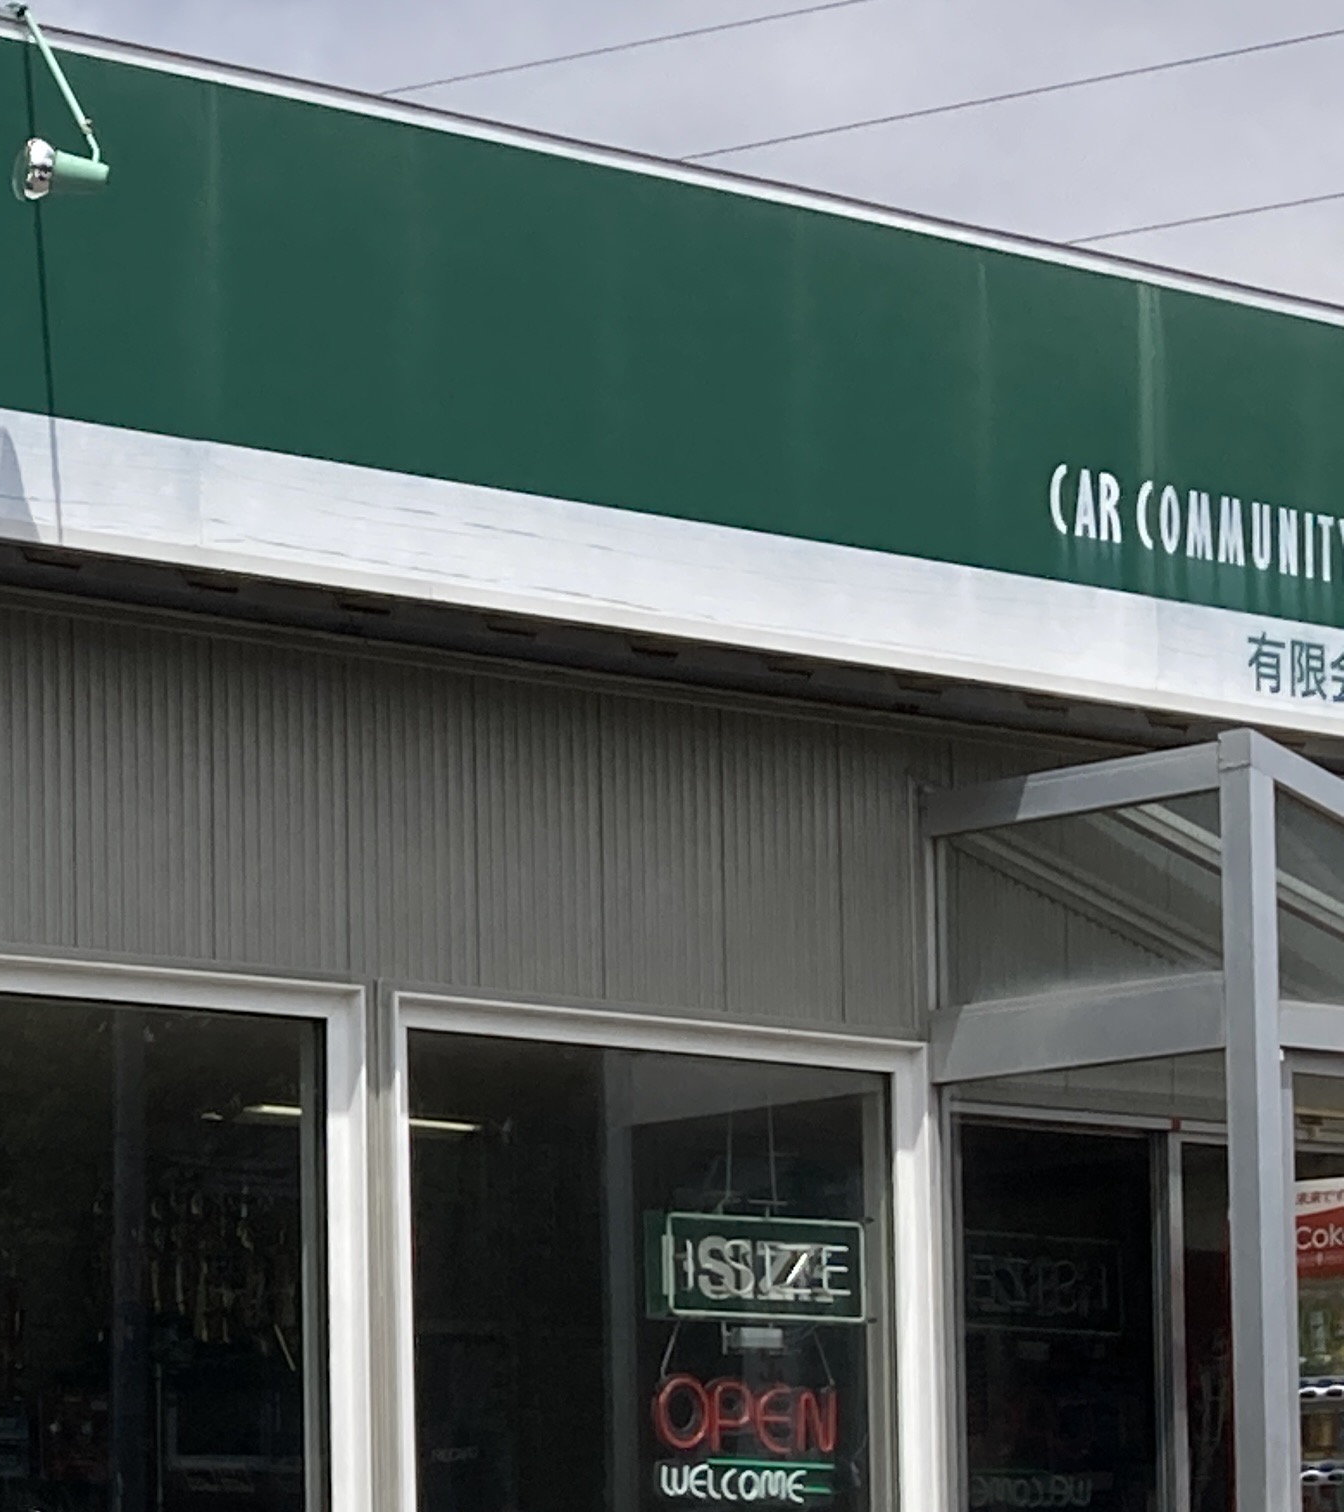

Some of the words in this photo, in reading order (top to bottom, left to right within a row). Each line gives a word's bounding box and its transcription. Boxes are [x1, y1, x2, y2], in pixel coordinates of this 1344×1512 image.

[1050, 463, 1123, 543] CAR
[1296, 1222, 1344, 1251] Cok
[655, 1372, 838, 1455] OPEN
[661, 1463, 807, 1504] WELCOME
